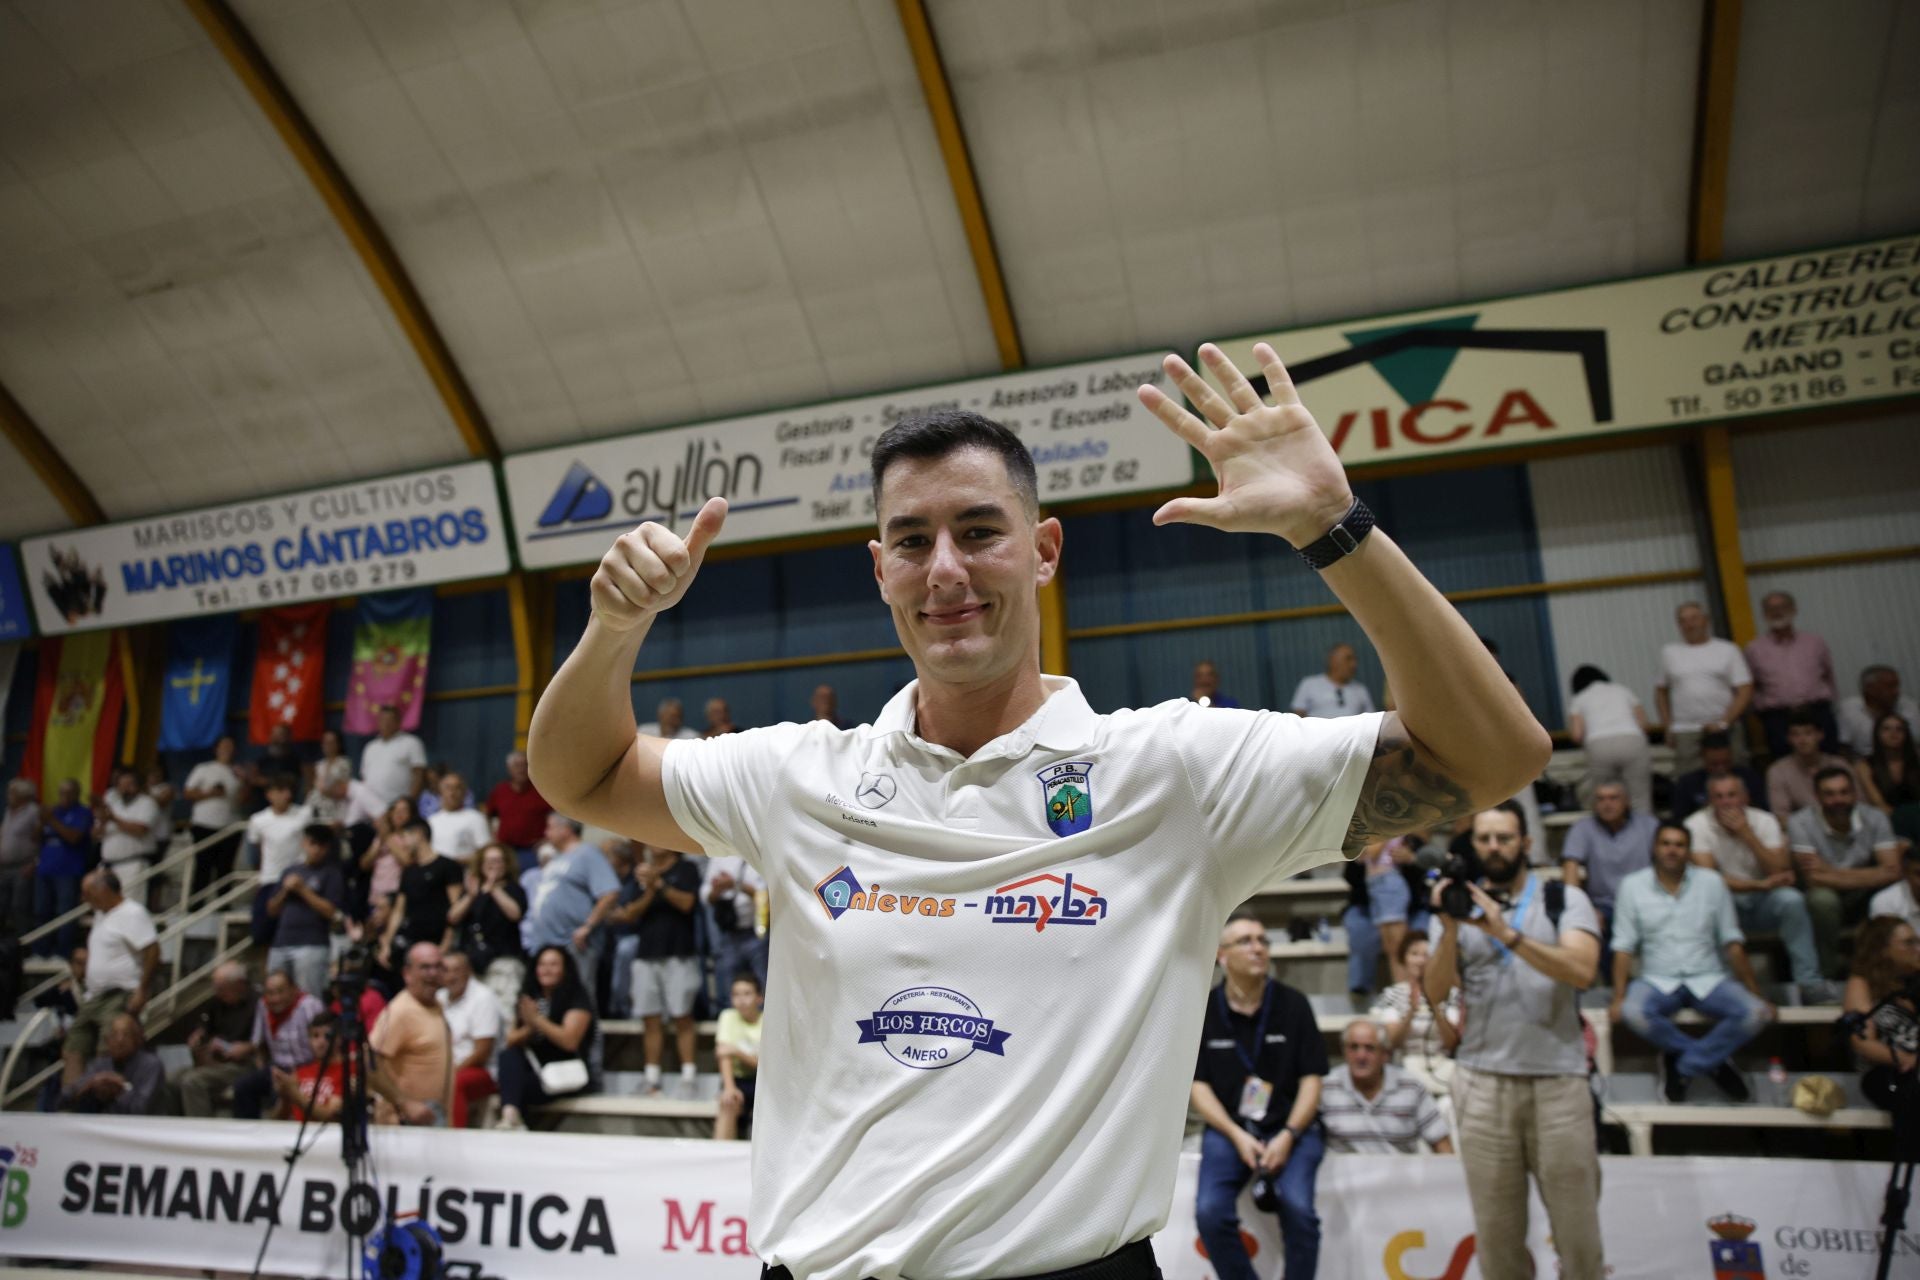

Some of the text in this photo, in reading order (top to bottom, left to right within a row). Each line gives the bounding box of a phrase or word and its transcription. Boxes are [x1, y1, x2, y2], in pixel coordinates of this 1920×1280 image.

[1703, 348, 1842, 386] GAJANO
[1050, 401, 1131, 430] Escuela
[780, 442, 834, 469] Fiscal
[133, 473, 457, 548] MARISCOS Y CULTIVOS
[121, 506, 488, 595] MARINOS CÁNTABROS
[257, 574, 300, 600] 617
[312, 567, 358, 593] 060
[368, 558, 417, 584] 279
[985, 873, 1107, 932] mayba
[930, 991, 972, 1011] RESTAURANTE
[876, 1014, 989, 1040] LOS ARCOS
[902, 1045, 949, 1062] ANERO
[60, 1161, 619, 1255] SEMANA BOLÍSTICA
[1779, 1252, 1810, 1276] de
